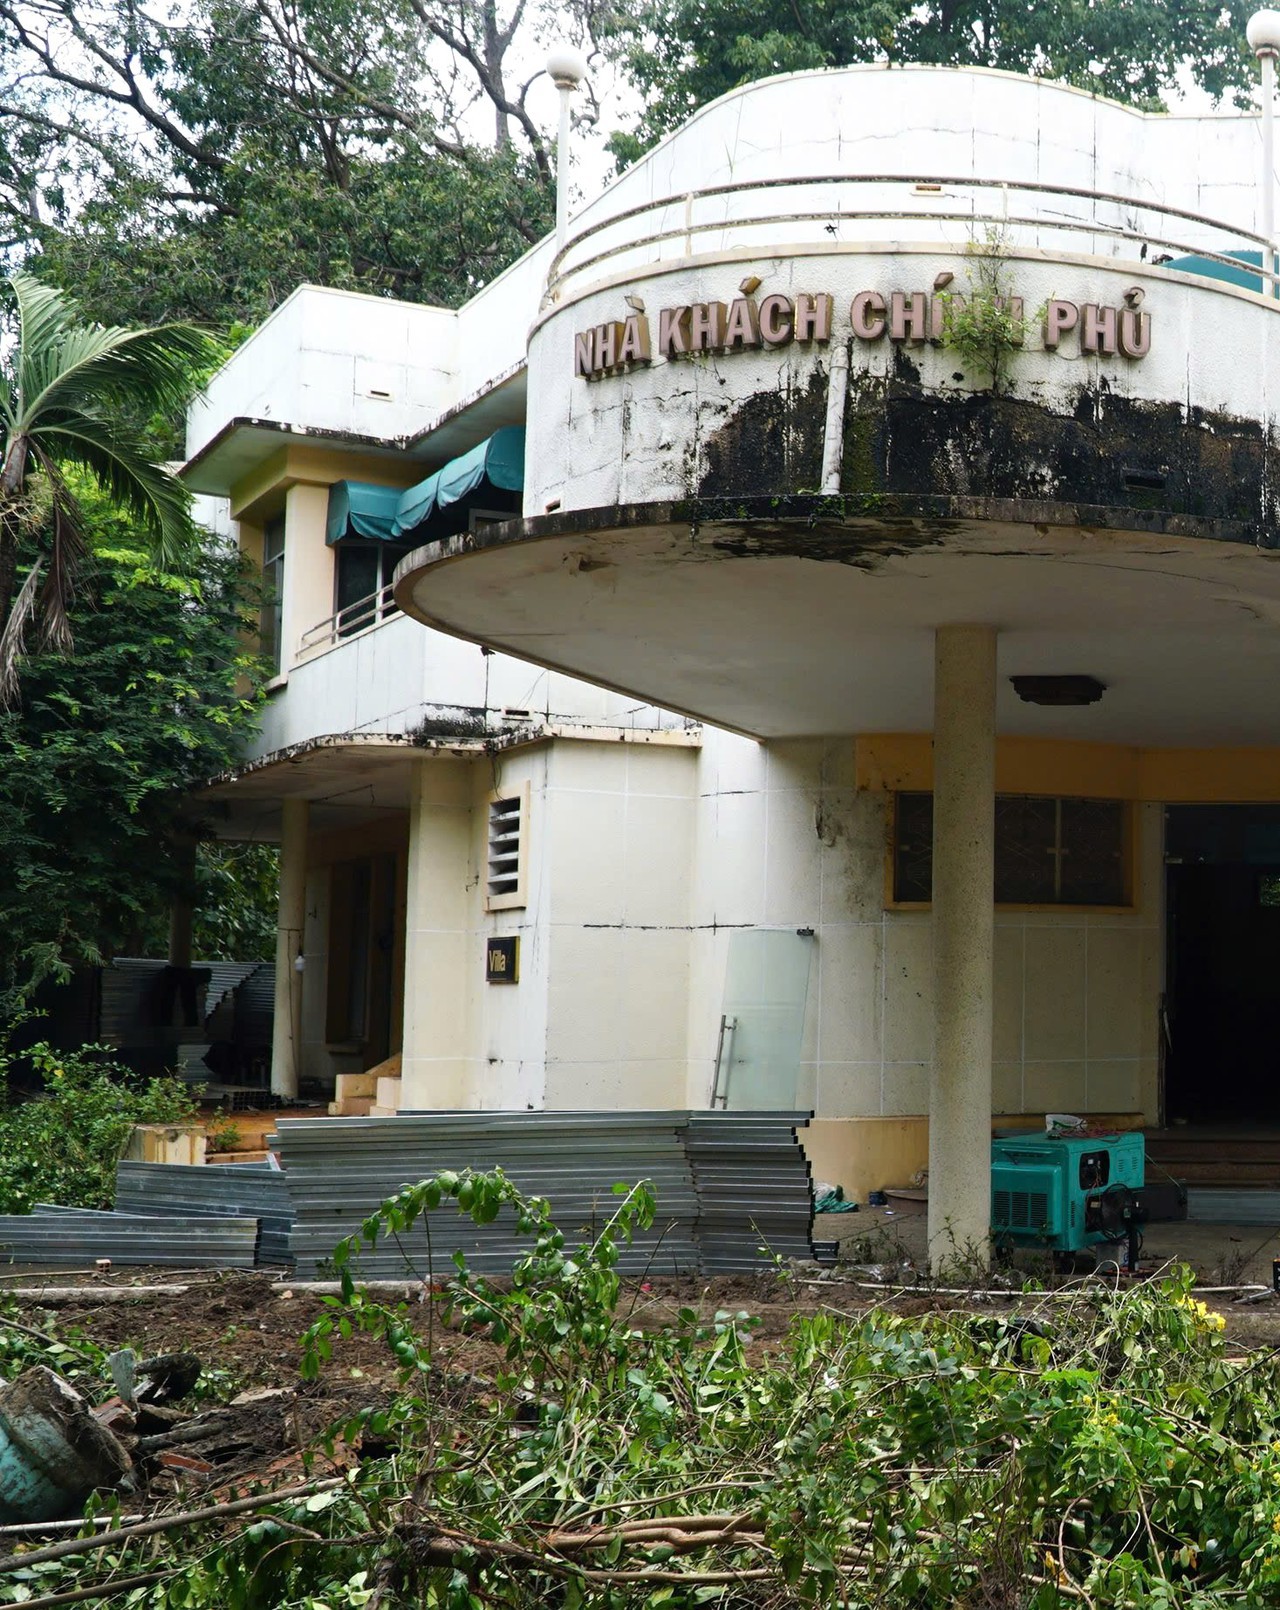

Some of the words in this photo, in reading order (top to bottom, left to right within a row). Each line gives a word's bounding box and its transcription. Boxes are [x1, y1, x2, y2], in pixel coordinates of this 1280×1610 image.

[574, 294, 652, 380] NHÀ
[659, 275, 832, 358] KHÁCH
[1044, 286, 1151, 358] PHỦ
